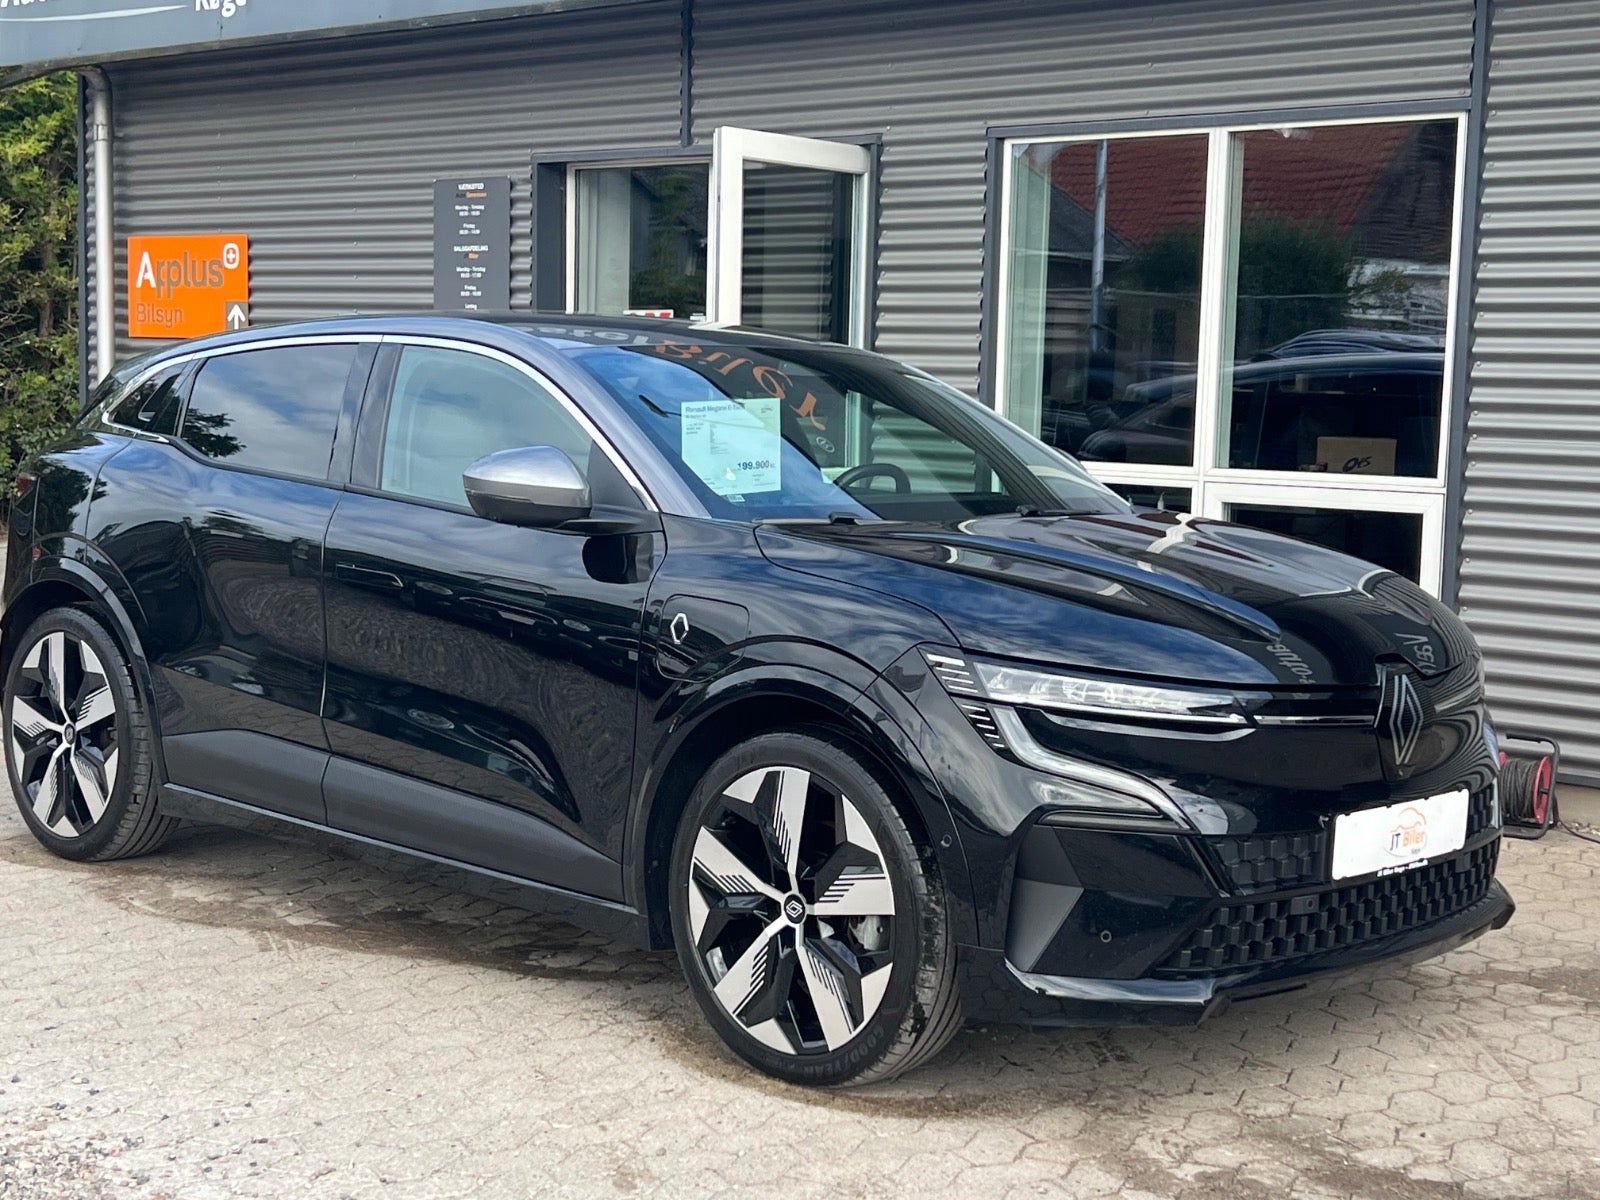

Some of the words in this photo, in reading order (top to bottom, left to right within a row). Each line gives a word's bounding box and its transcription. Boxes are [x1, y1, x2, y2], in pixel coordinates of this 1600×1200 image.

[136, 303, 183, 328] Bilsyn
[737, 460, 770, 471] 199.900
[1403, 831, 1425, 847] Biler
